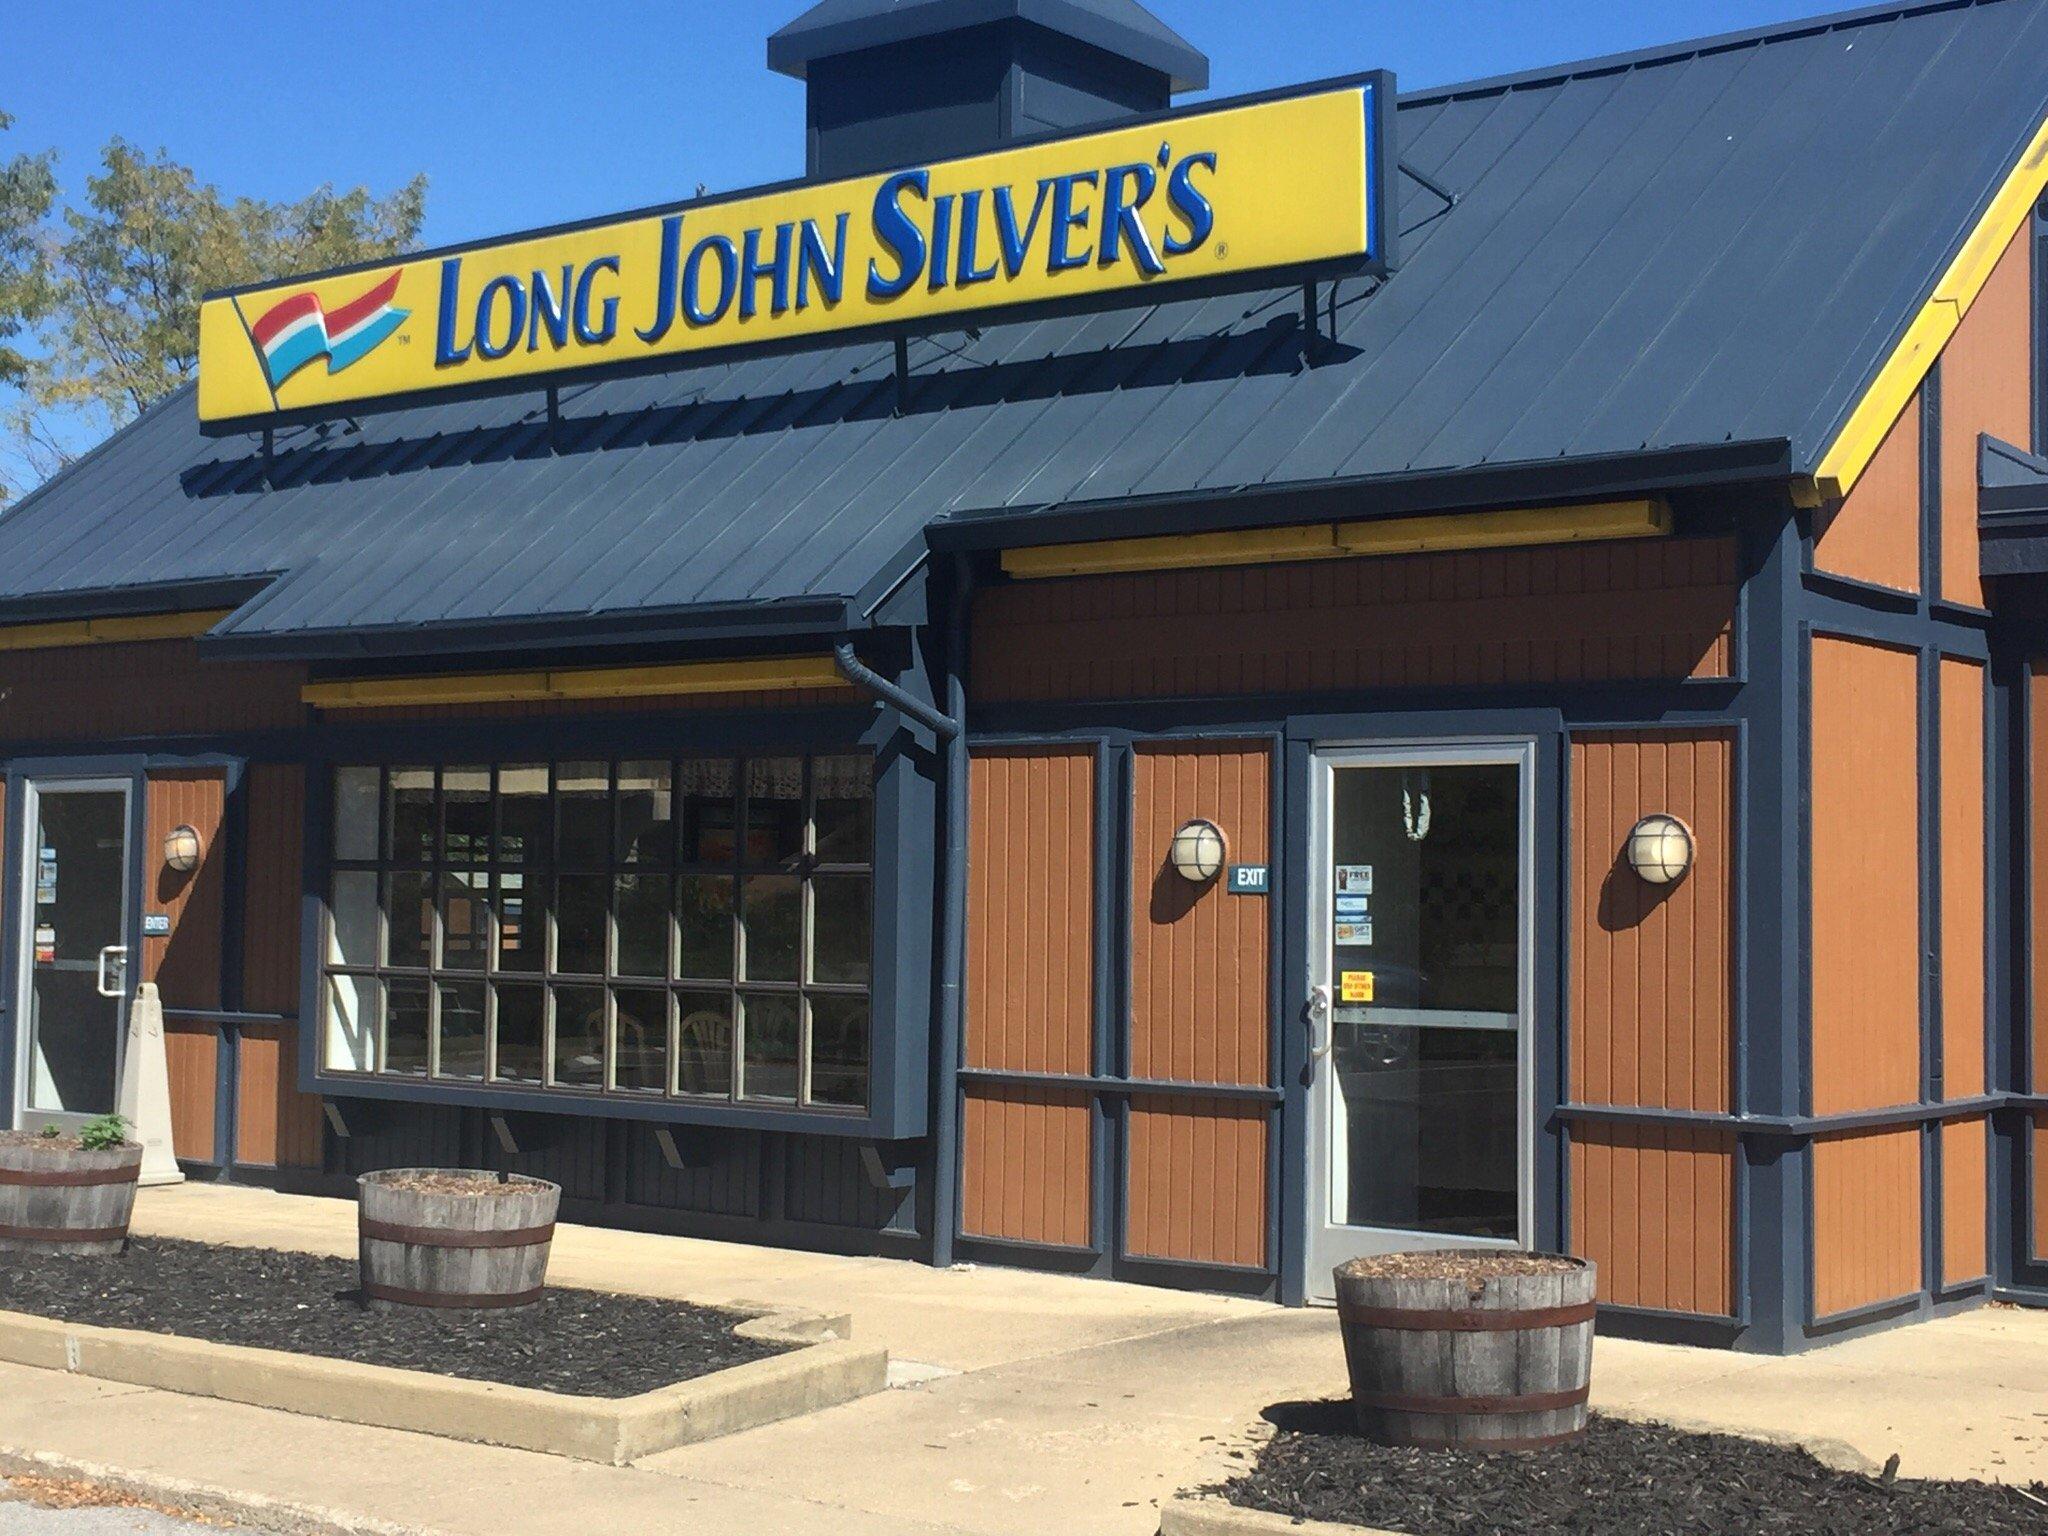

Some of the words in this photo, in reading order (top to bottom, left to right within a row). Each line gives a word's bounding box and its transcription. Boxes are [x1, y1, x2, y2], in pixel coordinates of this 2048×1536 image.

[434, 256, 620, 370] LONG
[634, 212, 850, 345] JOHN
[866, 140, 1217, 302] SILVER'S
[1237, 867, 1266, 885] EXIT
